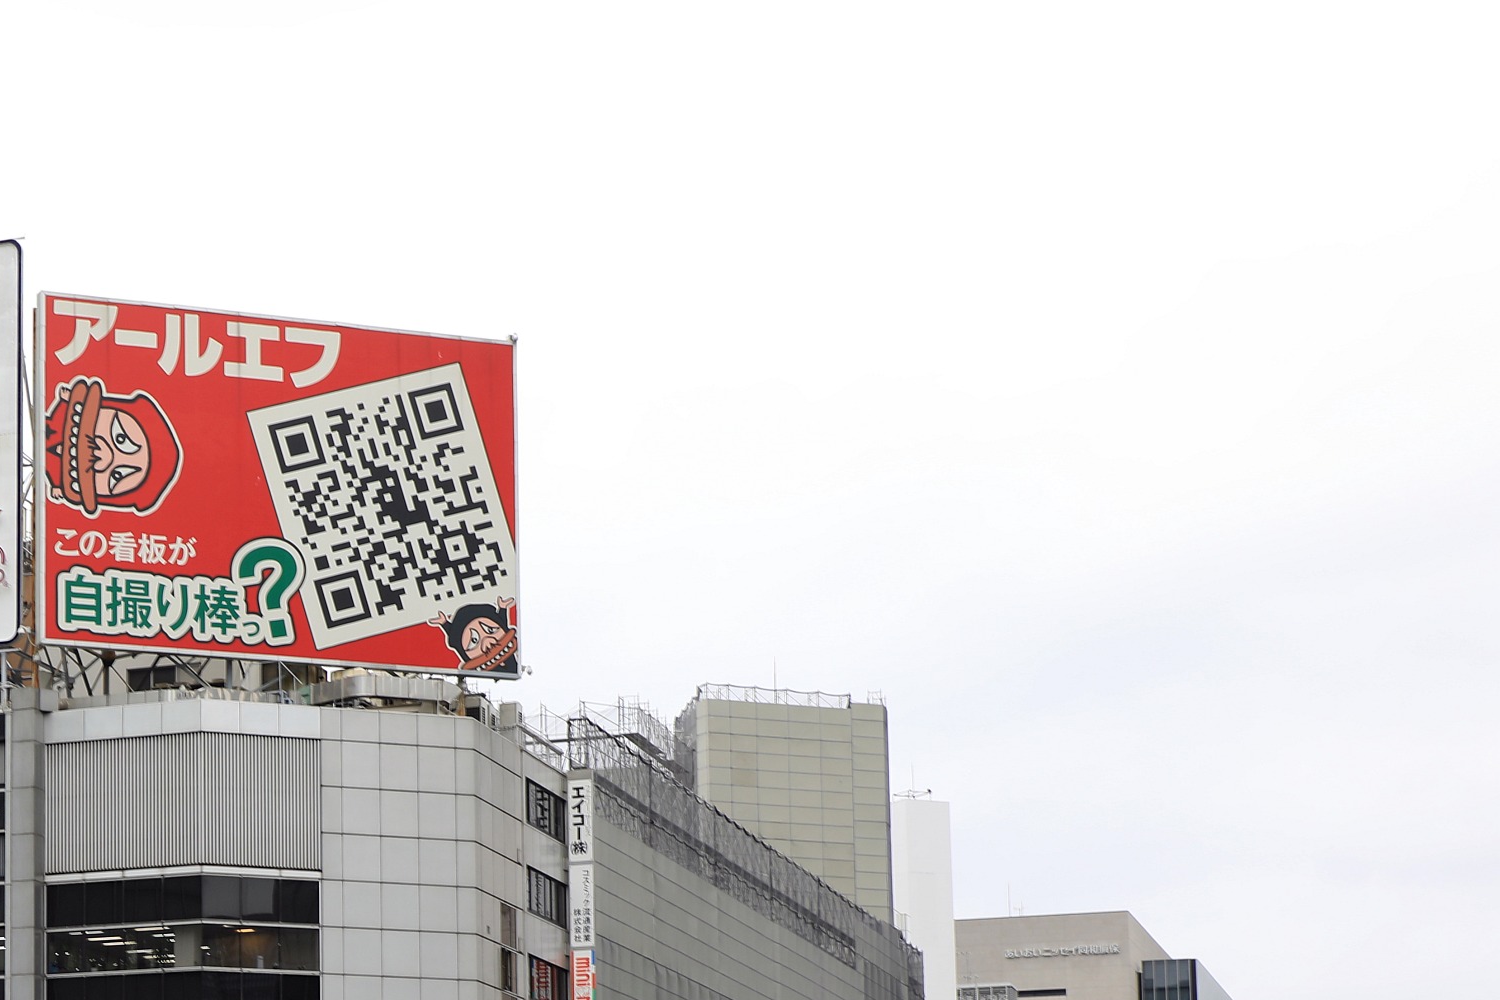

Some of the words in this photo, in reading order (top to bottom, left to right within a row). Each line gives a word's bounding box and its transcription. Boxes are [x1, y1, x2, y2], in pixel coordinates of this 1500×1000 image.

[53, 299, 341, 387] アールエフ
[53, 527, 197, 567] この看板が
[573, 908, 582, 943] 株式会社
[576, 957, 591, 987] mini
